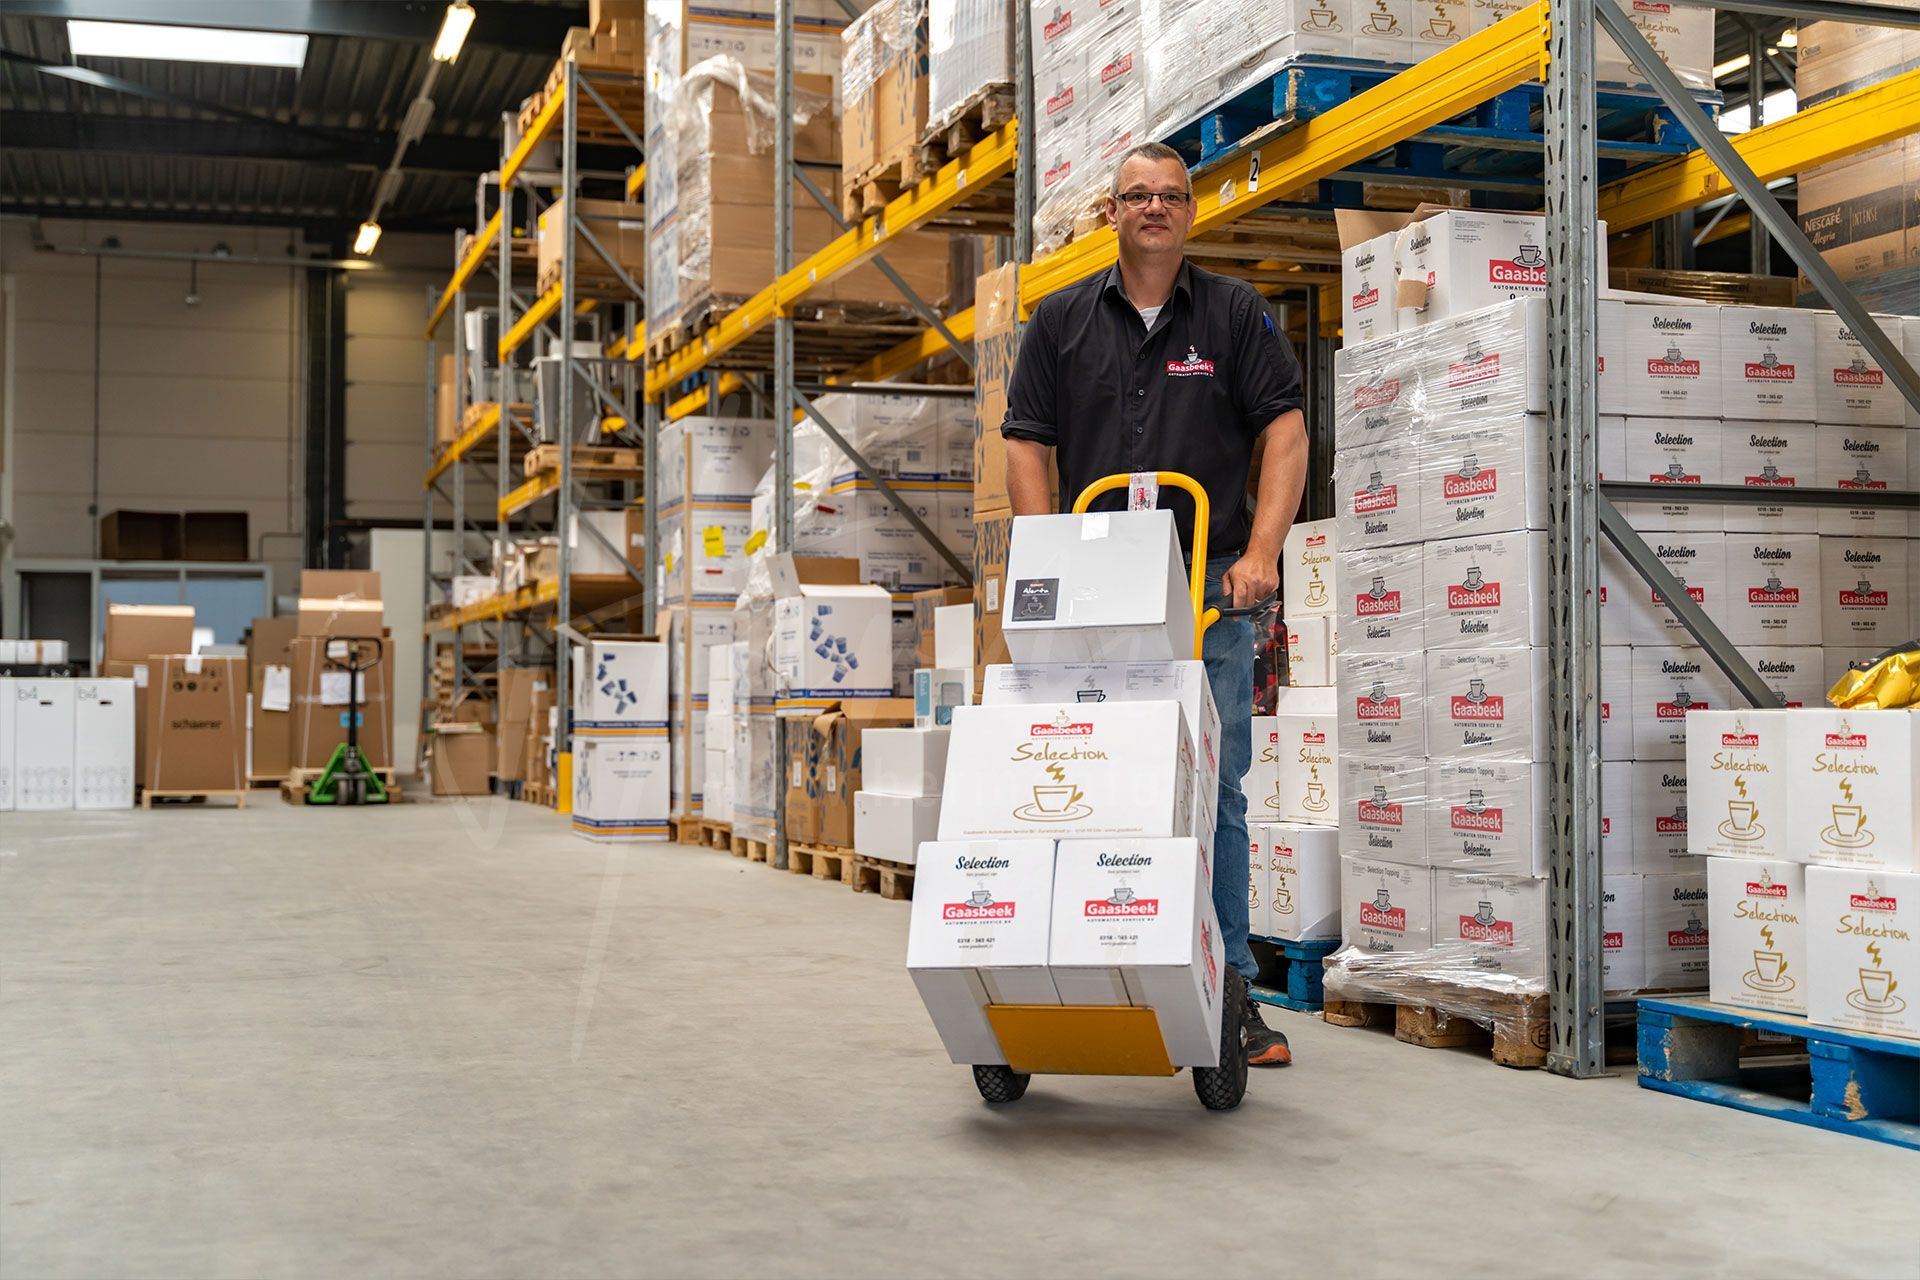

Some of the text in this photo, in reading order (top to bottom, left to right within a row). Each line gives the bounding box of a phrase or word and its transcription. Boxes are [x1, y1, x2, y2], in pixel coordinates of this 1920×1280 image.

[1250, 157, 1258, 181] 2
[1804, 207, 1878, 232] NESCAFÉ INTENSE
[1410, 235, 1431, 251] Selection
[1811, 231, 1836, 245] Alegria
[1355, 254, 1375, 268] Selection
[1492, 265, 1546, 282] Gaasbe
[1652, 316, 1692, 330] Selection
[1749, 321, 1787, 335] Selection
[1650, 362, 1698, 373] Gaasbeek
[1746, 367, 1793, 378] Gaasbeek
[1836, 372, 1881, 383] Gaasbeek
[1655, 432, 1693, 446] Selection
[1749, 434, 1787, 449] Selection
[1843, 438, 1880, 452] Selection
[1445, 473, 1495, 495] Gaasbeek
[1355, 491, 1396, 511] Gaasbeek
[1455, 506, 1485, 522] Selection
[1365, 521, 1388, 535] Selection
[1454, 542, 1492, 553] Selection Topping
[1656, 545, 1697, 558] Selection
[1753, 546, 1792, 559] Selection
[1301, 550, 1332, 566] Selection
[1844, 549, 1881, 563] Selection
[1450, 588, 1499, 606] Gaasbeek
[1750, 591, 1798, 601] Gaasbeek
[1841, 594, 1886, 604] Gaasbeek
[1358, 598, 1400, 613] Gaasbeek
[1366, 626, 1391, 639] Selection
[1459, 618, 1489, 634] Selection
[1457, 654, 1494, 665] Selection Topping
[1758, 660, 1795, 673] Selection
[1662, 660, 1701, 674] Selection
[1358, 703, 1400, 718] Gaasbeek
[1453, 700, 1502, 718] Gaasbeek
[171, 718, 222, 731] schaerer
[1032, 725, 1091, 736] Gaasbeek's
[1367, 729, 1392, 744] Selection
[1463, 730, 1493, 746] Selection
[1722, 736, 1758, 746] Gaasbeek's
[1827, 736, 1866, 746] Gaasbeek's
[1010, 741, 1109, 762] Selection
[1299, 747, 1332, 765] Selection
[1363, 763, 1395, 773] Selection Topping
[1710, 752, 1769, 773] Selection
[1812, 753, 1879, 775] Selection
[1458, 765, 1494, 777] Selection Topping
[1360, 805, 1402, 823] Gaasbeek
[1453, 811, 1501, 829] Gaasbeek
[1368, 834, 1393, 849] Selection
[1463, 841, 1492, 857] Selection
[955, 855, 1010, 870] Selection
[1096, 852, 1152, 867] Selection
[1271, 858, 1297, 876] Selection
[1367, 866, 1400, 878] Selection Topping
[1466, 876, 1504, 889] Selection Topping
[1747, 885, 1787, 897] Gaasbeek's
[1086, 902, 1156, 915] Gaasbeek
[1851, 897, 1896, 910] Gaasbeek's
[945, 904, 1014, 918] Gaasbeek
[1362, 908, 1404, 928] Gaasbeek
[1733, 900, 1799, 924] Selection
[1461, 920, 1511, 944] Gaasbeek
[1836, 914, 1910, 941] Selection
[1368, 936, 1394, 952] Selection
